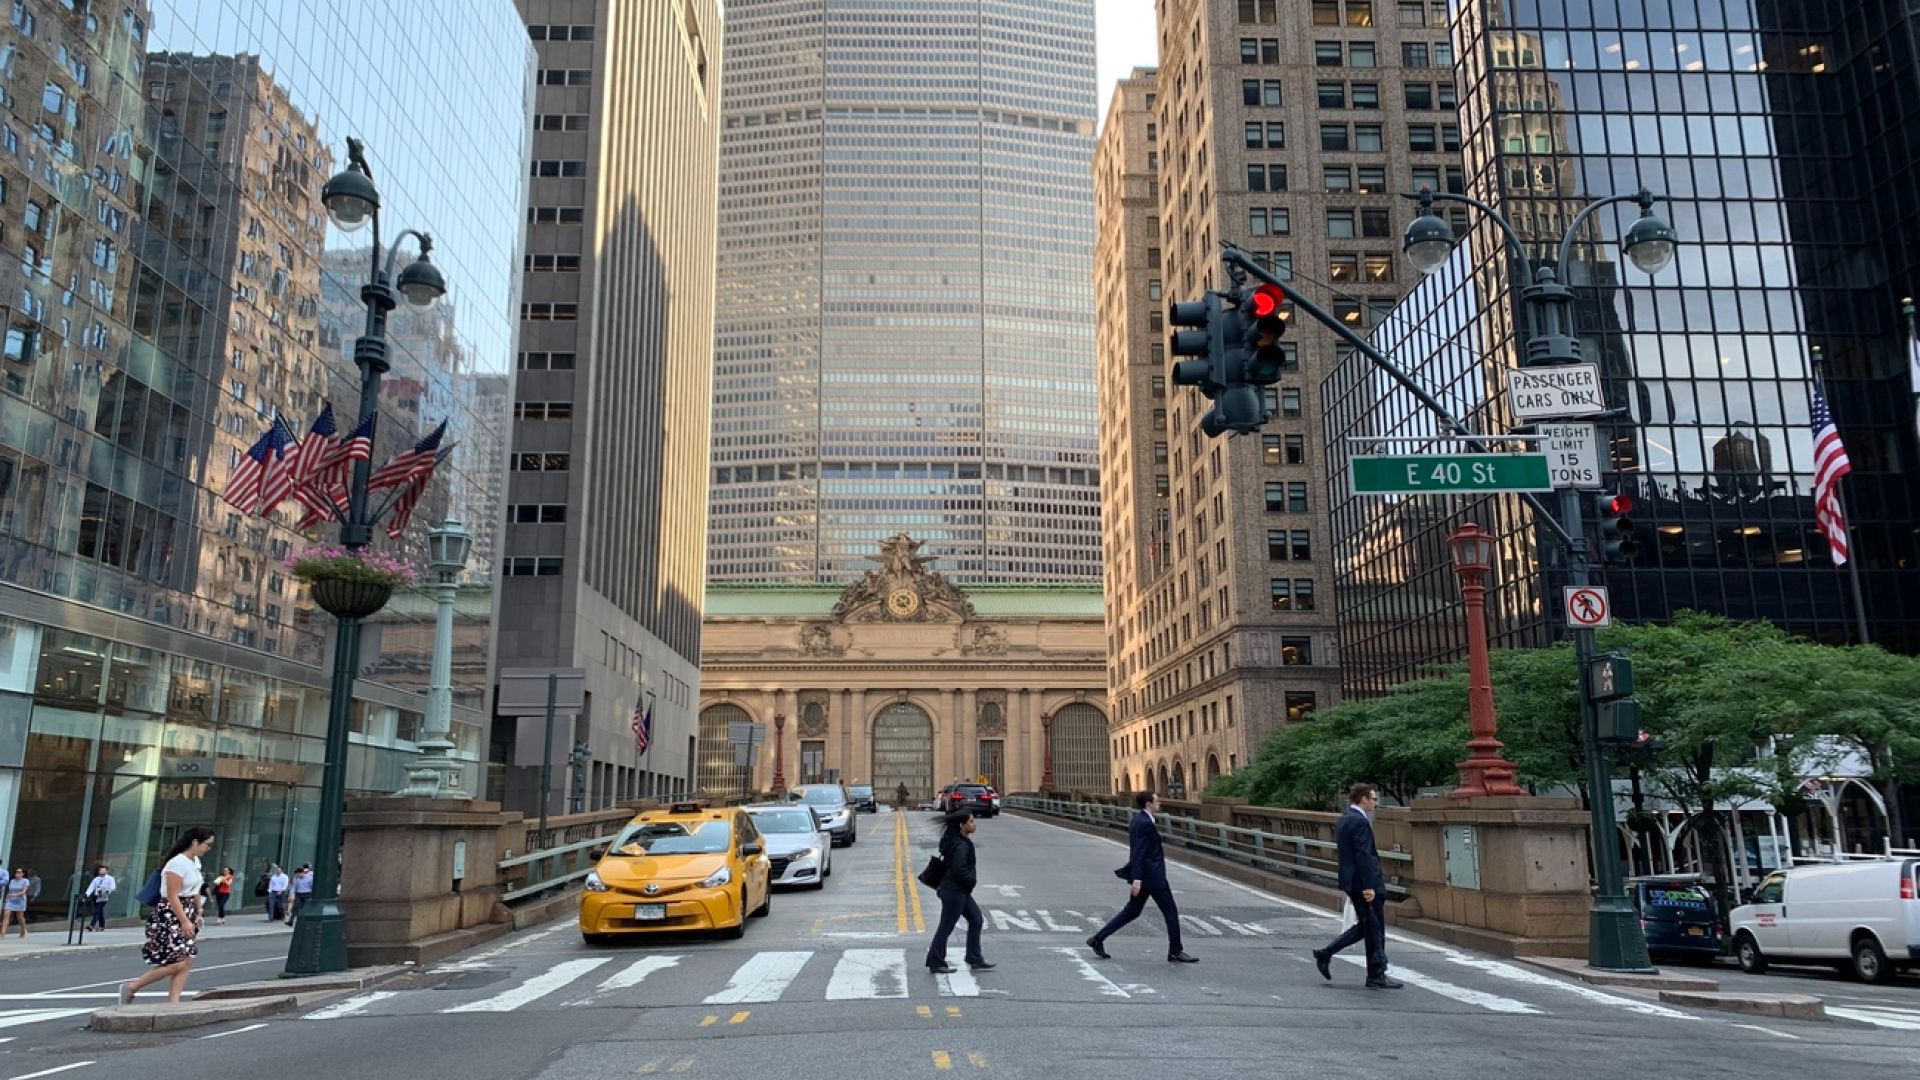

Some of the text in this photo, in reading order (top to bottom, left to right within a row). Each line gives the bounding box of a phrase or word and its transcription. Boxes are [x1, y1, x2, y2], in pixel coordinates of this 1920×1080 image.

[1513, 371, 1593, 390] PASSENGER
[1517, 389, 1595, 409] CARS ONLY
[1543, 427, 1590, 438] WEIGHT
[1551, 440, 1585, 451] LIMIT
[1560, 453, 1579, 466] 15
[1406, 461, 1497, 485] E 40 St
[1551, 468, 1593, 481] TONS
